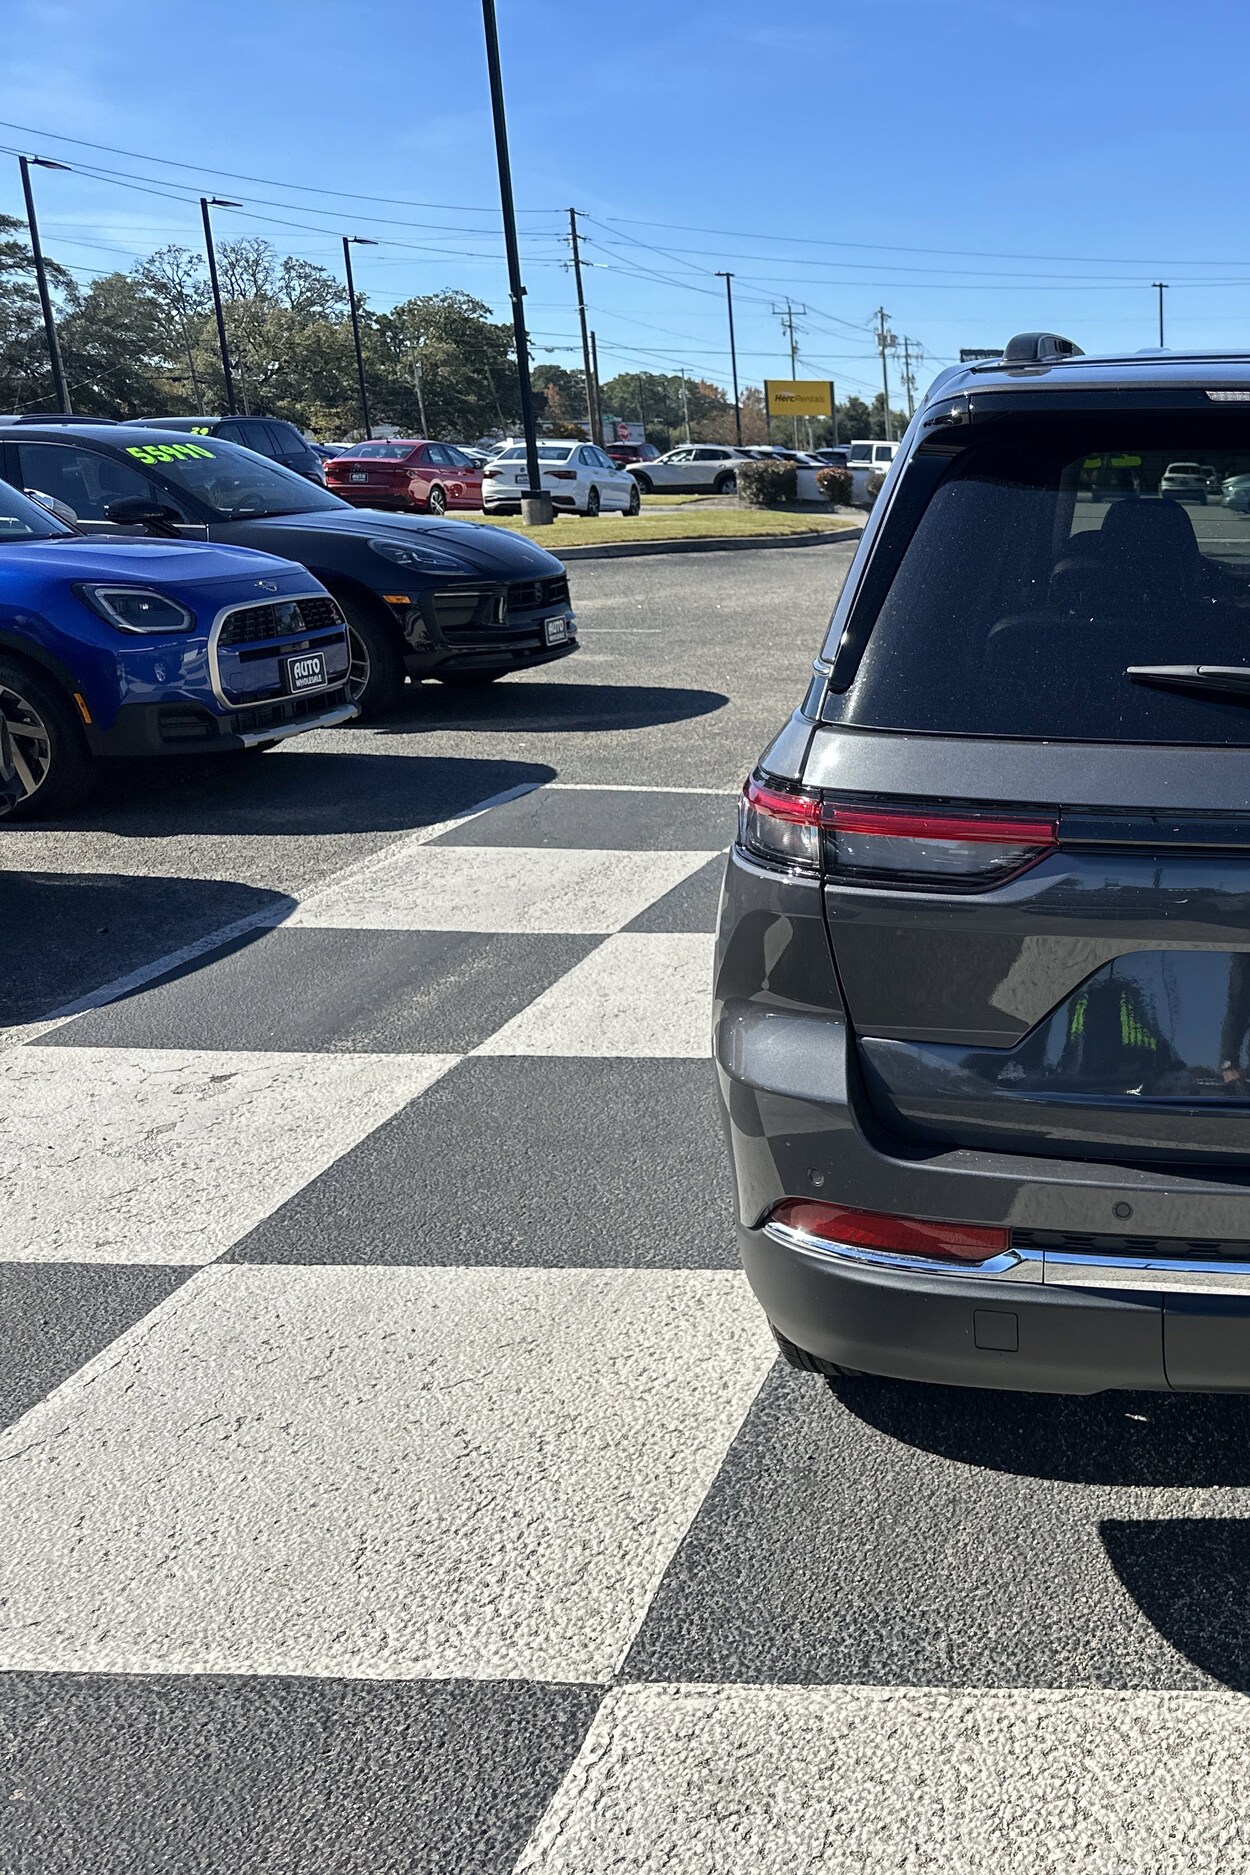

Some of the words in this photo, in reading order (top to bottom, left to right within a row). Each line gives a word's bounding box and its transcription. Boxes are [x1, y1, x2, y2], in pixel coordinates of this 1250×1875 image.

[125, 443, 216, 465] 55990
[548, 620, 564, 635] AUTO
[293, 658, 320, 679] AUTO
